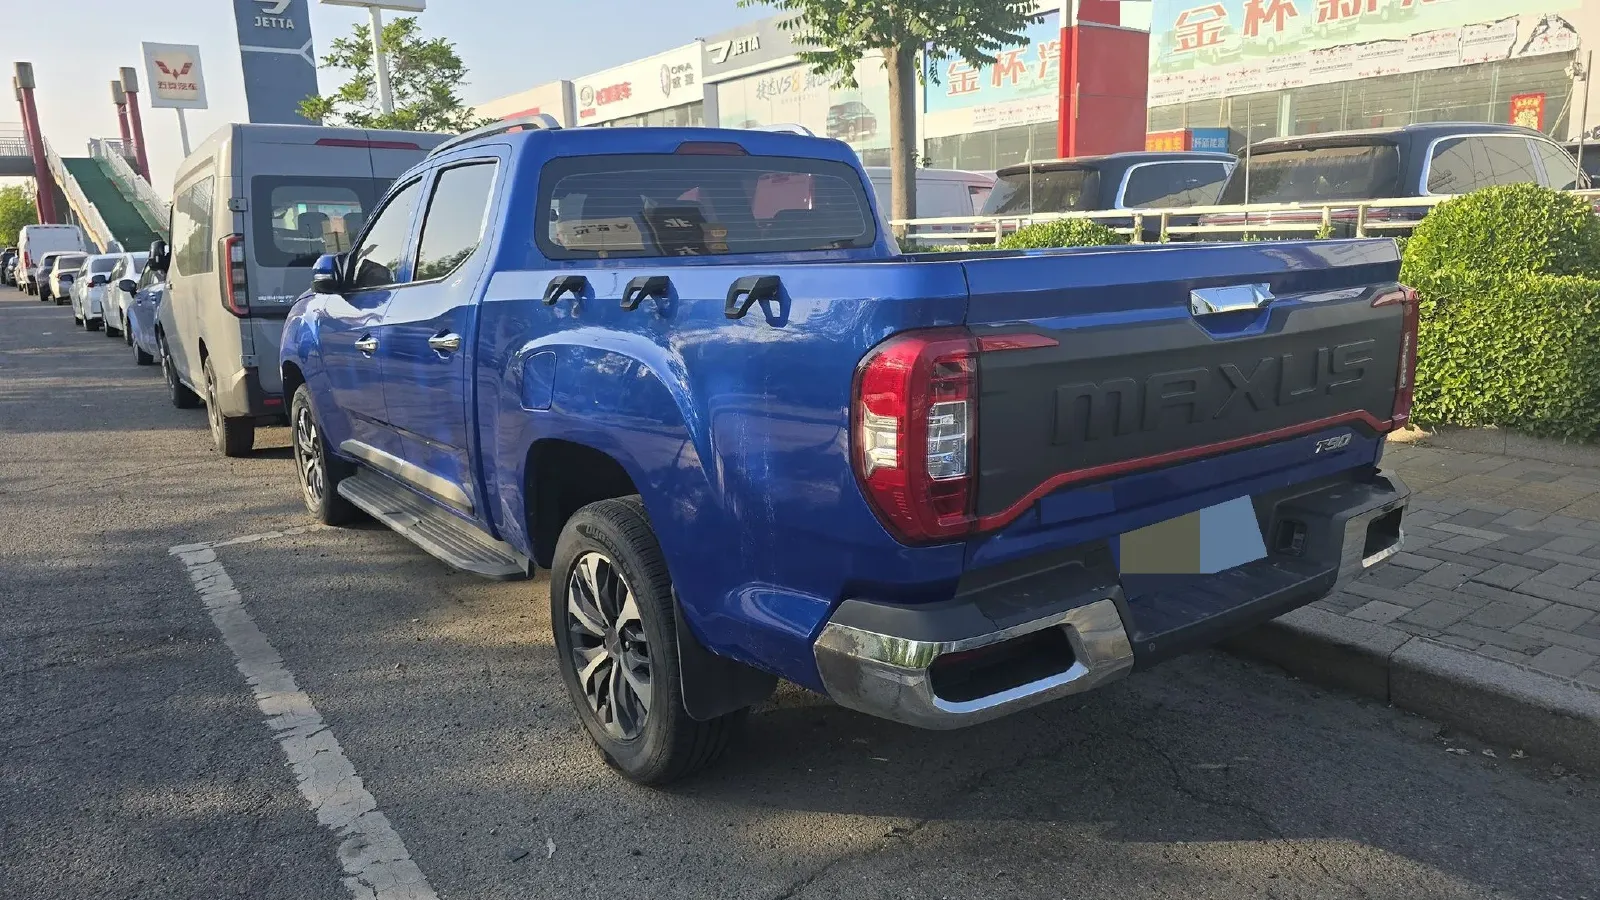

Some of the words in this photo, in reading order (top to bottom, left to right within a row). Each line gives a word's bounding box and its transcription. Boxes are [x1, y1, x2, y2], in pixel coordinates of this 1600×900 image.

[254, 16, 295, 30] JETTA
[671, 62, 693, 75] ORA
[1192, 137, 1226, 149] 杯新能源
[1051, 339, 1375, 445] MAXUS
[1315, 433, 1352, 453] T90
